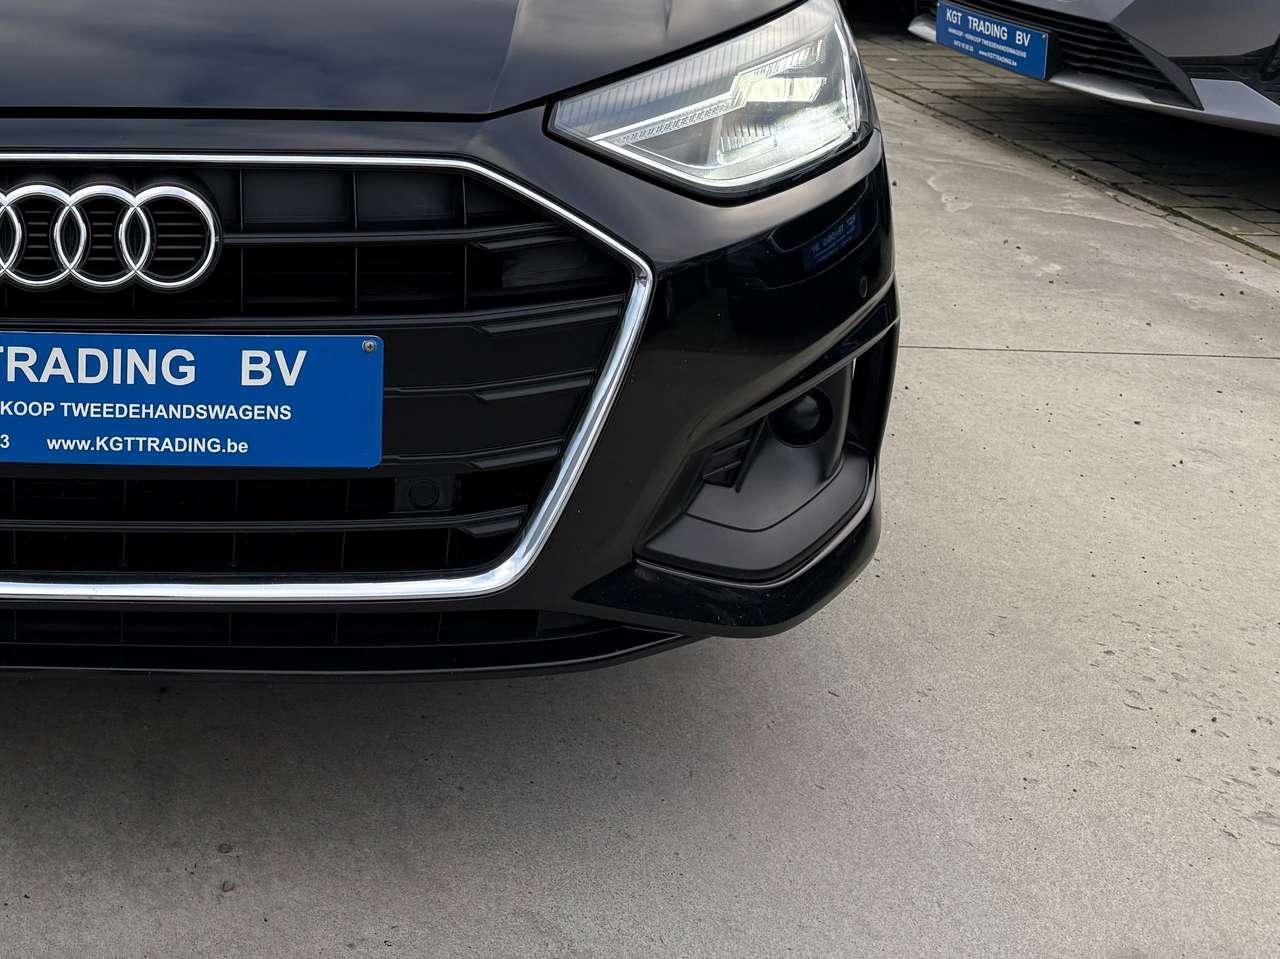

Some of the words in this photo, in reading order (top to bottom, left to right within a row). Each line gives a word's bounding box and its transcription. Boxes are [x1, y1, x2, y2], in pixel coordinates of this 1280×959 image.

[946, 8, 962, 25] KGT
[967, 16, 1008, 40] TRADING
[1015, 30, 1032, 47] BV
[241, 349, 308, 387] BV
[60, 402, 293, 421] TWEEDEHANDSWAGENS
[46, 435, 249, 454] www.KGTTRADING.be
